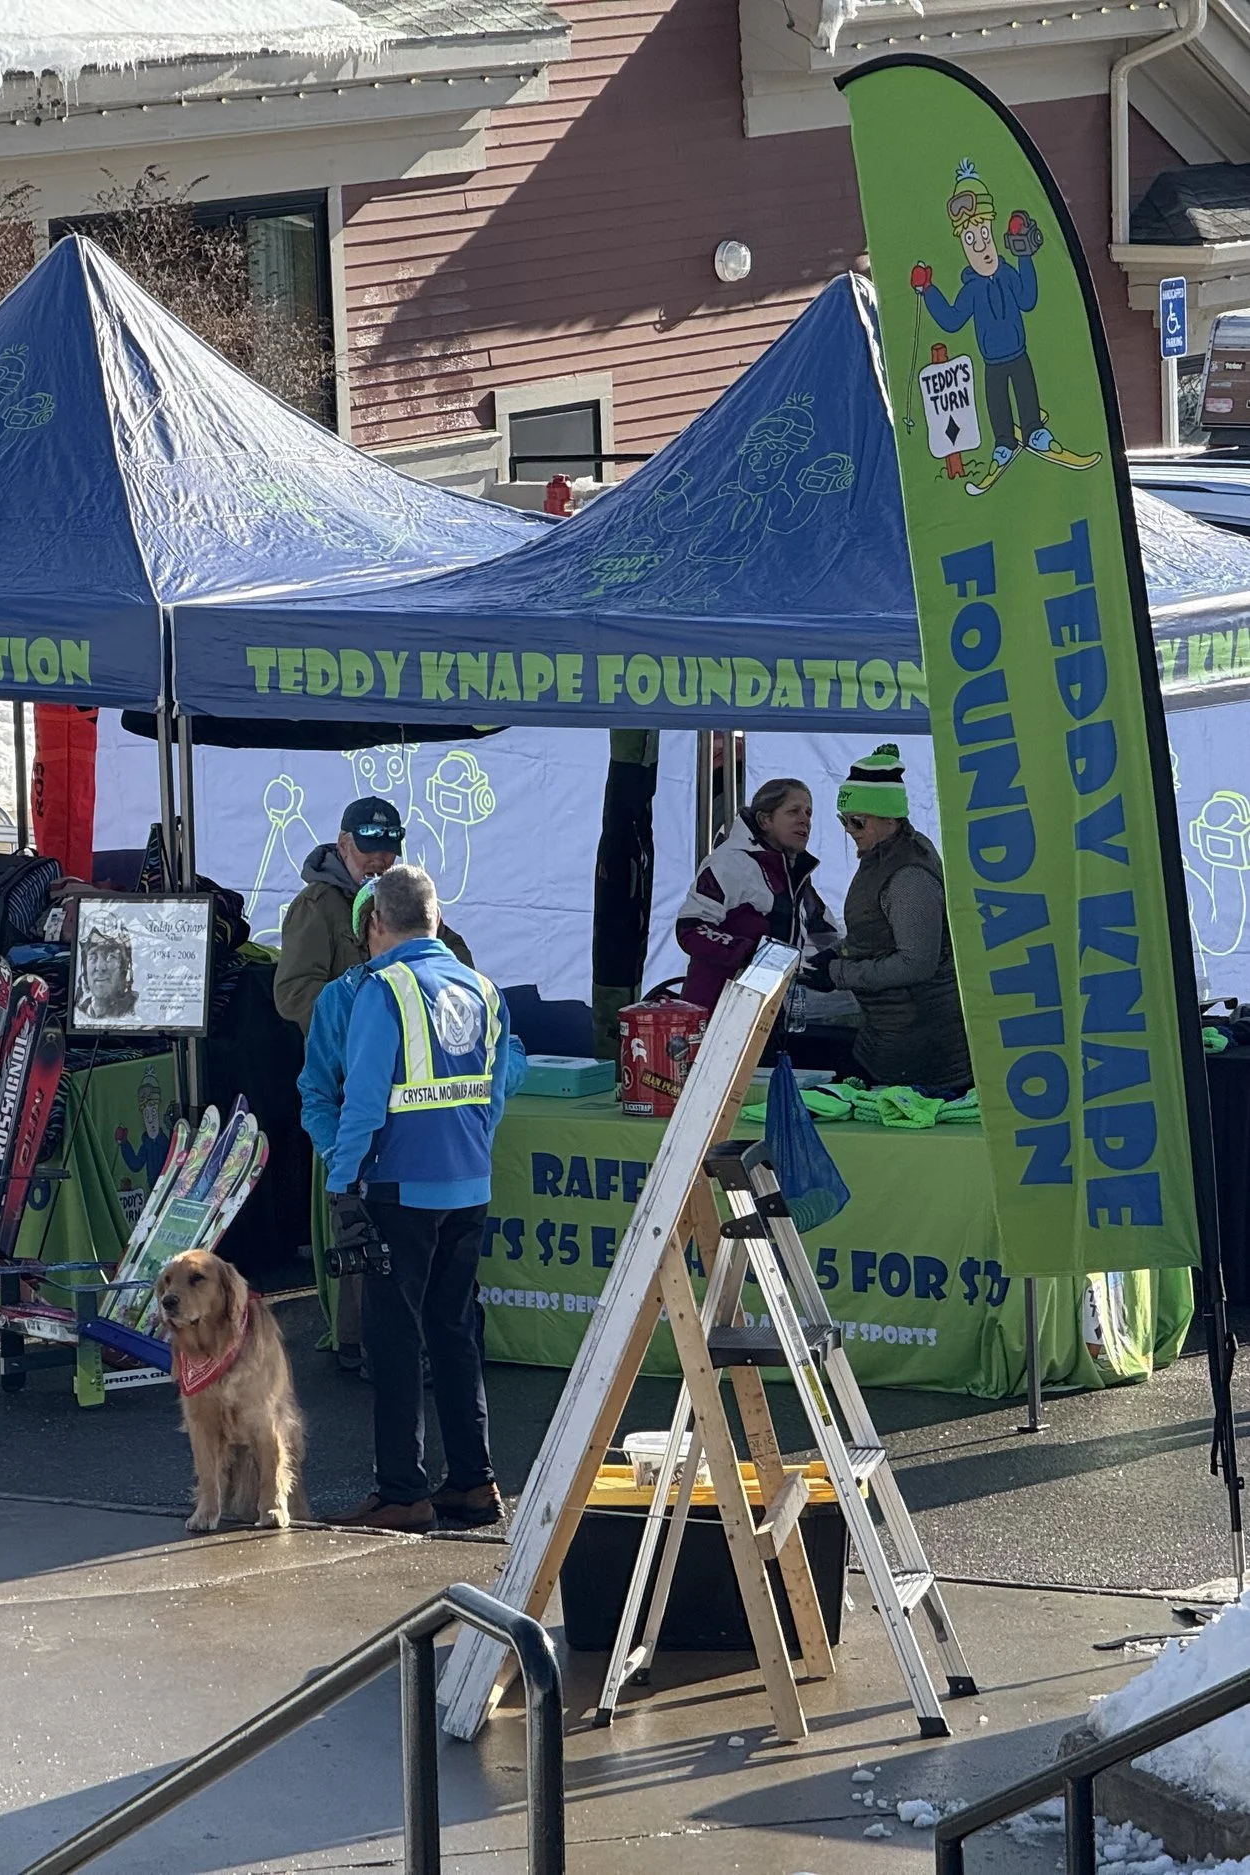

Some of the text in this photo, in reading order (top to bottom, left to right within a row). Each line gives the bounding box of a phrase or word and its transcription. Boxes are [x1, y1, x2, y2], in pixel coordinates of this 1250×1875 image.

[921, 363, 971, 394] TEDDY'S
[930, 387, 970, 415] TURN
[587, 569, 646, 584] TURN
[592, 553, 664, 571] TEDDY'S
[246, 646, 930, 711] TEDDY KNAPE FOUNDATION
[940, 540, 1073, 1187] FOUNDATION
[1035, 518, 1163, 1230] TEDDY KNAPE
[177, 951, 196, 959] 2006
[403, 1086, 439, 1104] CRYSTAL
[531, 1152, 653, 1203] RAFF
[536, 1218, 581, 1266] $5
[816, 1247, 840, 1290] 5
[851, 1250, 948, 1302] FOR
[477, 1286, 560, 1311] ROCEEDS
[859, 1322, 939, 1348] SPORTS
[103, 1374, 149, 1385] UROPA
